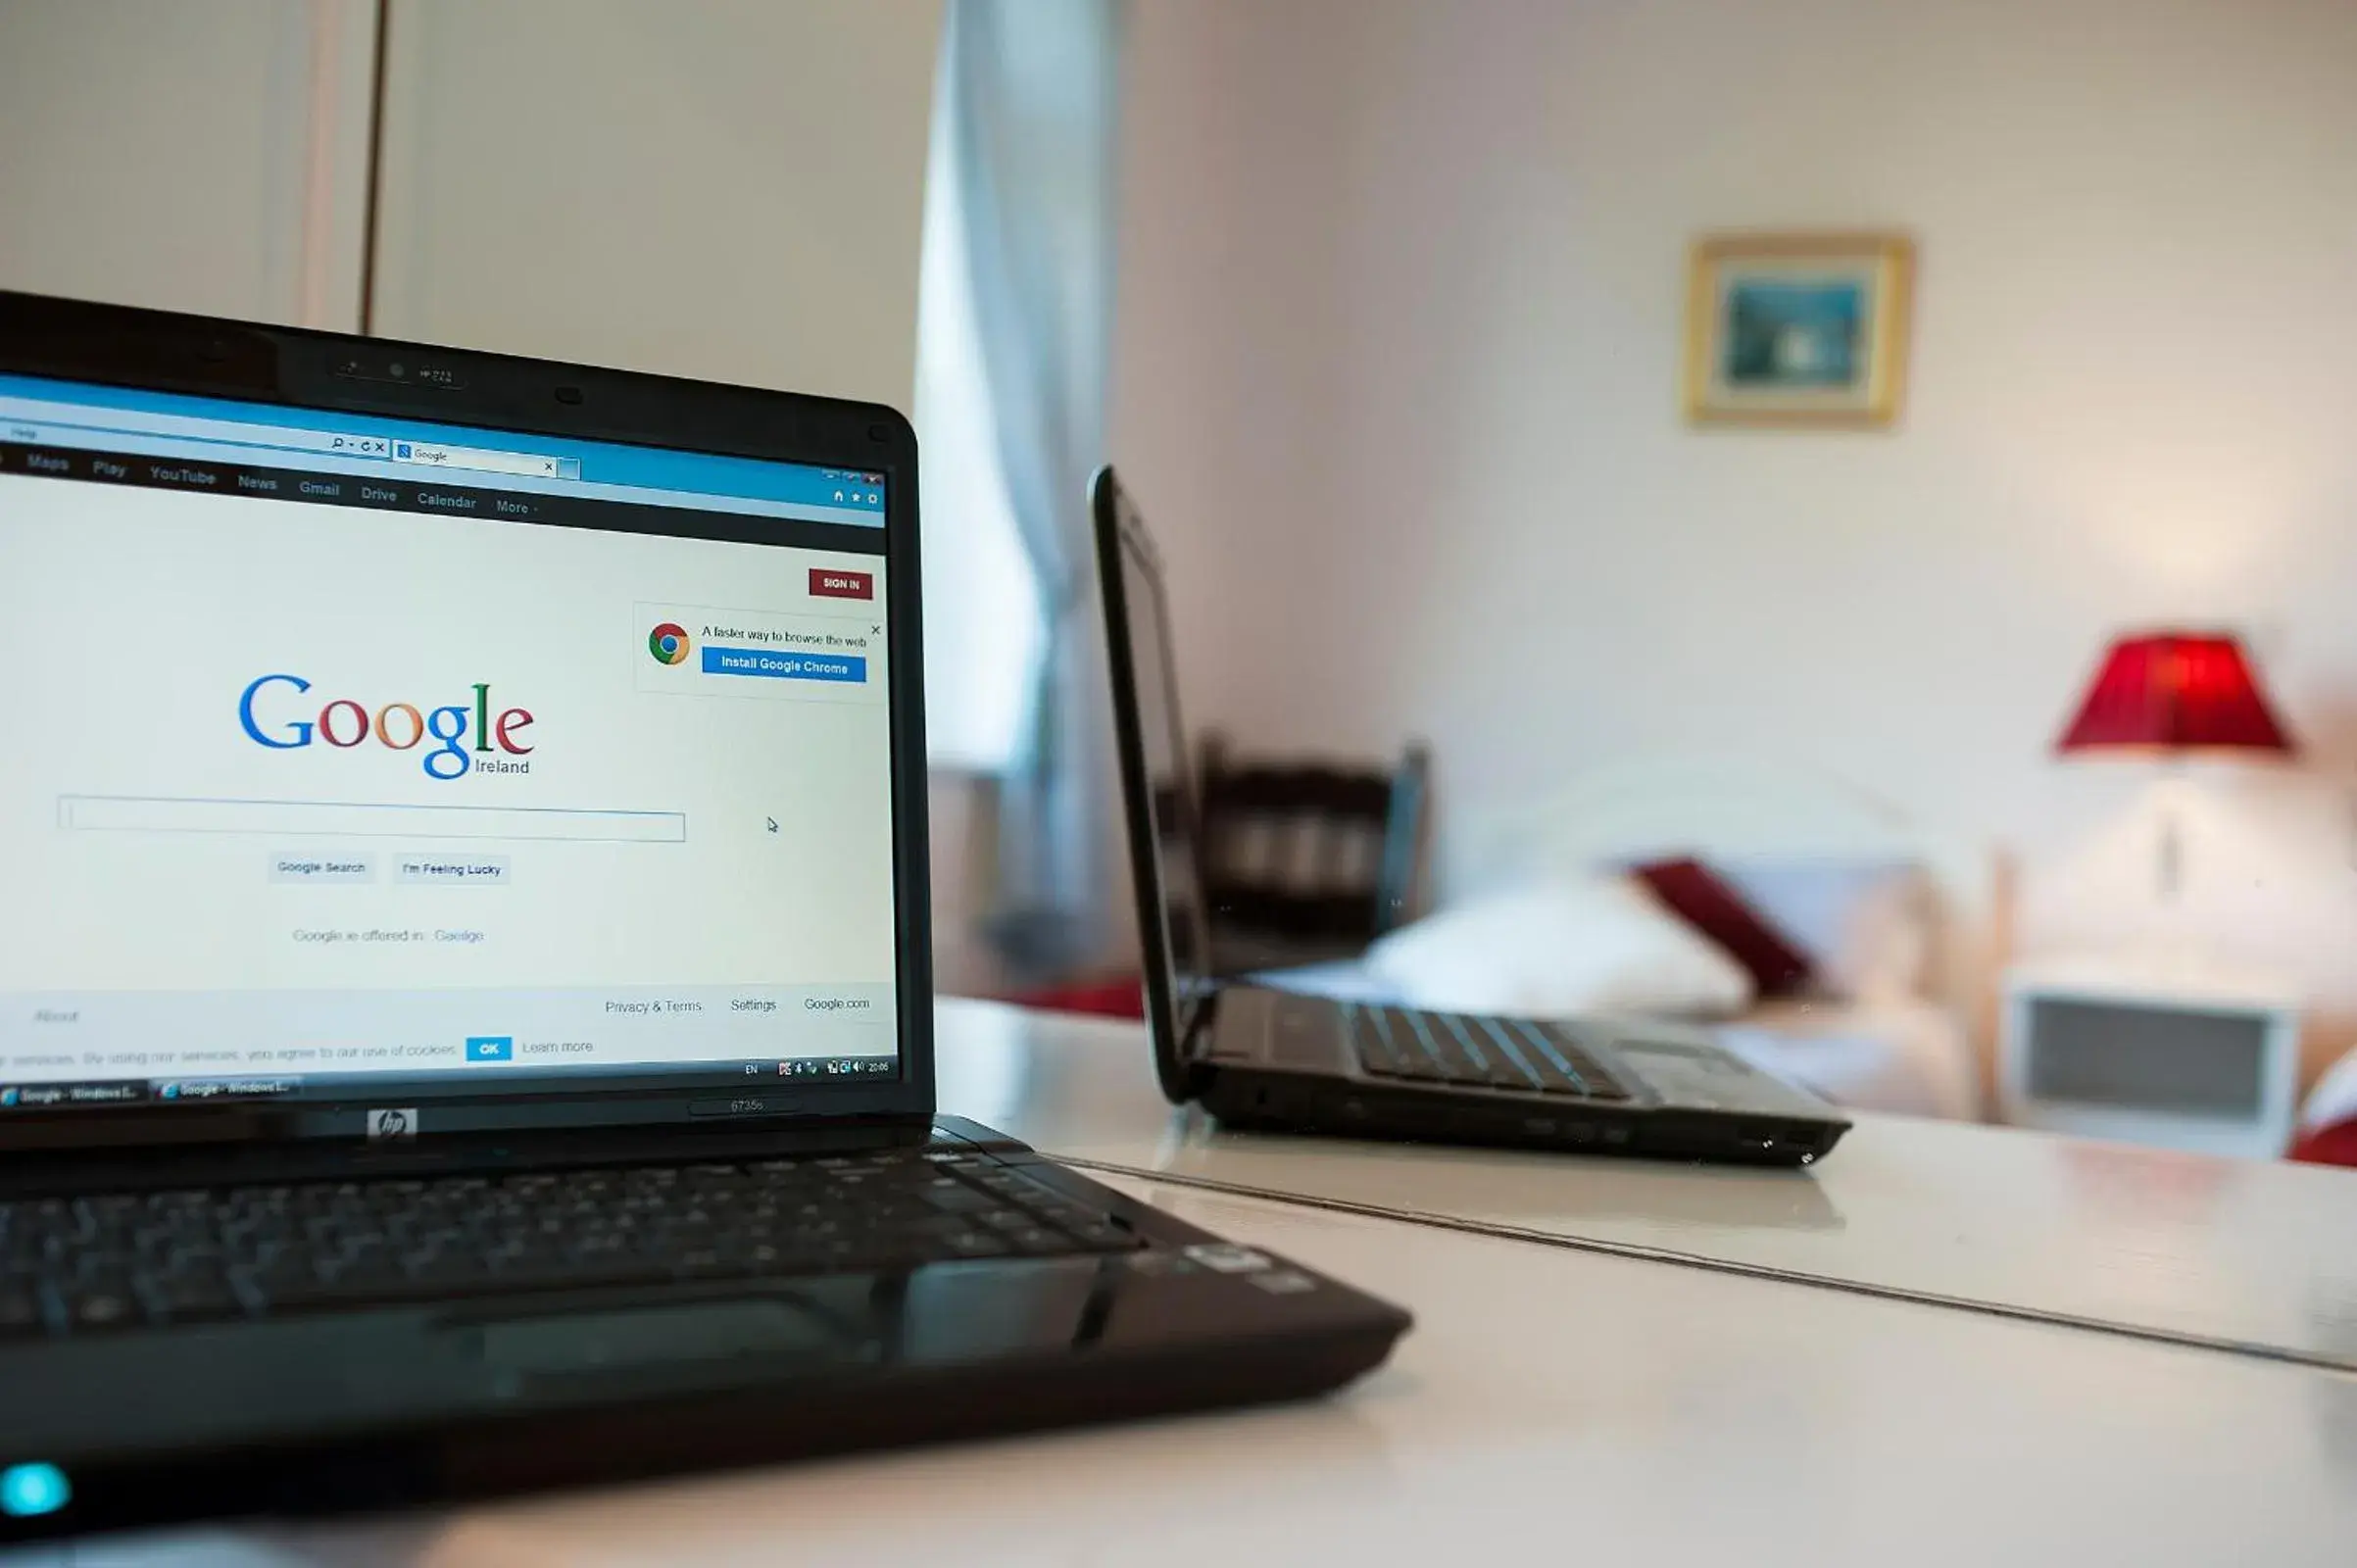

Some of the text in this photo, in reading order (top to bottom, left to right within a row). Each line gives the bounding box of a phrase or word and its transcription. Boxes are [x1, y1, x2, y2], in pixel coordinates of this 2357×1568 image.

[414, 448, 448, 462] Google
[26, 453, 529, 514] Maps Play YouTube News Gmail Drive Calendar More
[823, 577, 860, 590] SIGN IN
[702, 625, 866, 647] A faster way to browse the web
[721, 656, 849, 674] Install Google Chrome
[238, 674, 534, 779] Google
[475, 760, 529, 774] Ireland
[277, 860, 366, 874] Google Search
[402, 862, 501, 876] I'm Feeling Lucky
[362, 929, 408, 942] offered
[606, 1000, 702, 1014] Privacy & Terms
[731, 999, 777, 1011] Settings
[804, 998, 870, 1010] Google.com
[34, 1010, 79, 1023] About
[362, 1047, 387, 1057] use
[391, 1045, 404, 1056] of
[477, 1043, 500, 1054] OK
[521, 1040, 594, 1054] Learn more
[745, 1064, 758, 1075] EN
